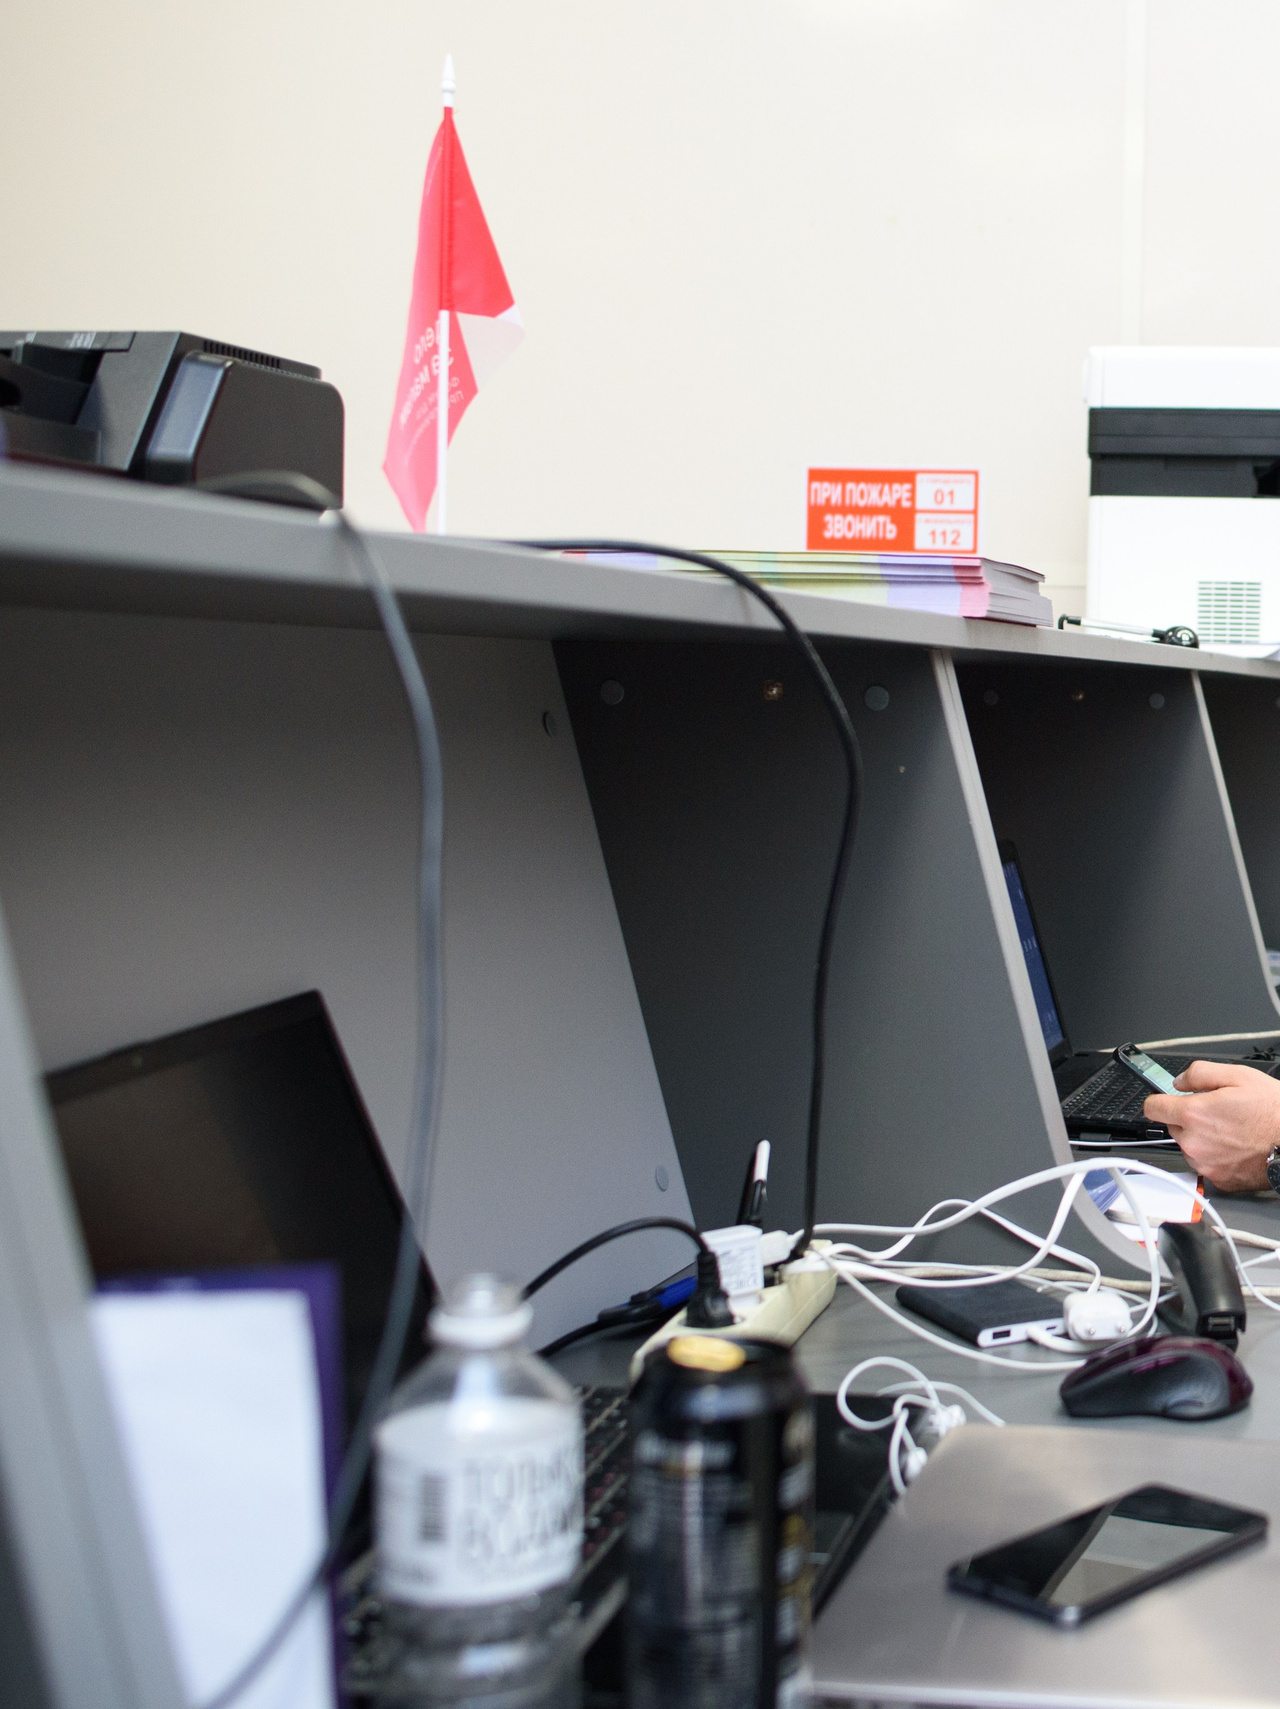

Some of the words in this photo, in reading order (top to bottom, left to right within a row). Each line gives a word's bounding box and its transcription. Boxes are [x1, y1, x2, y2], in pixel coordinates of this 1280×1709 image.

[810, 481, 842, 507] ПРИ
[845, 482, 913, 508] ПОЖАРЕ
[934, 488, 955, 506] 01
[822, 512, 898, 540] ЗВОНИТЬ
[929, 529, 961, 546] 112
